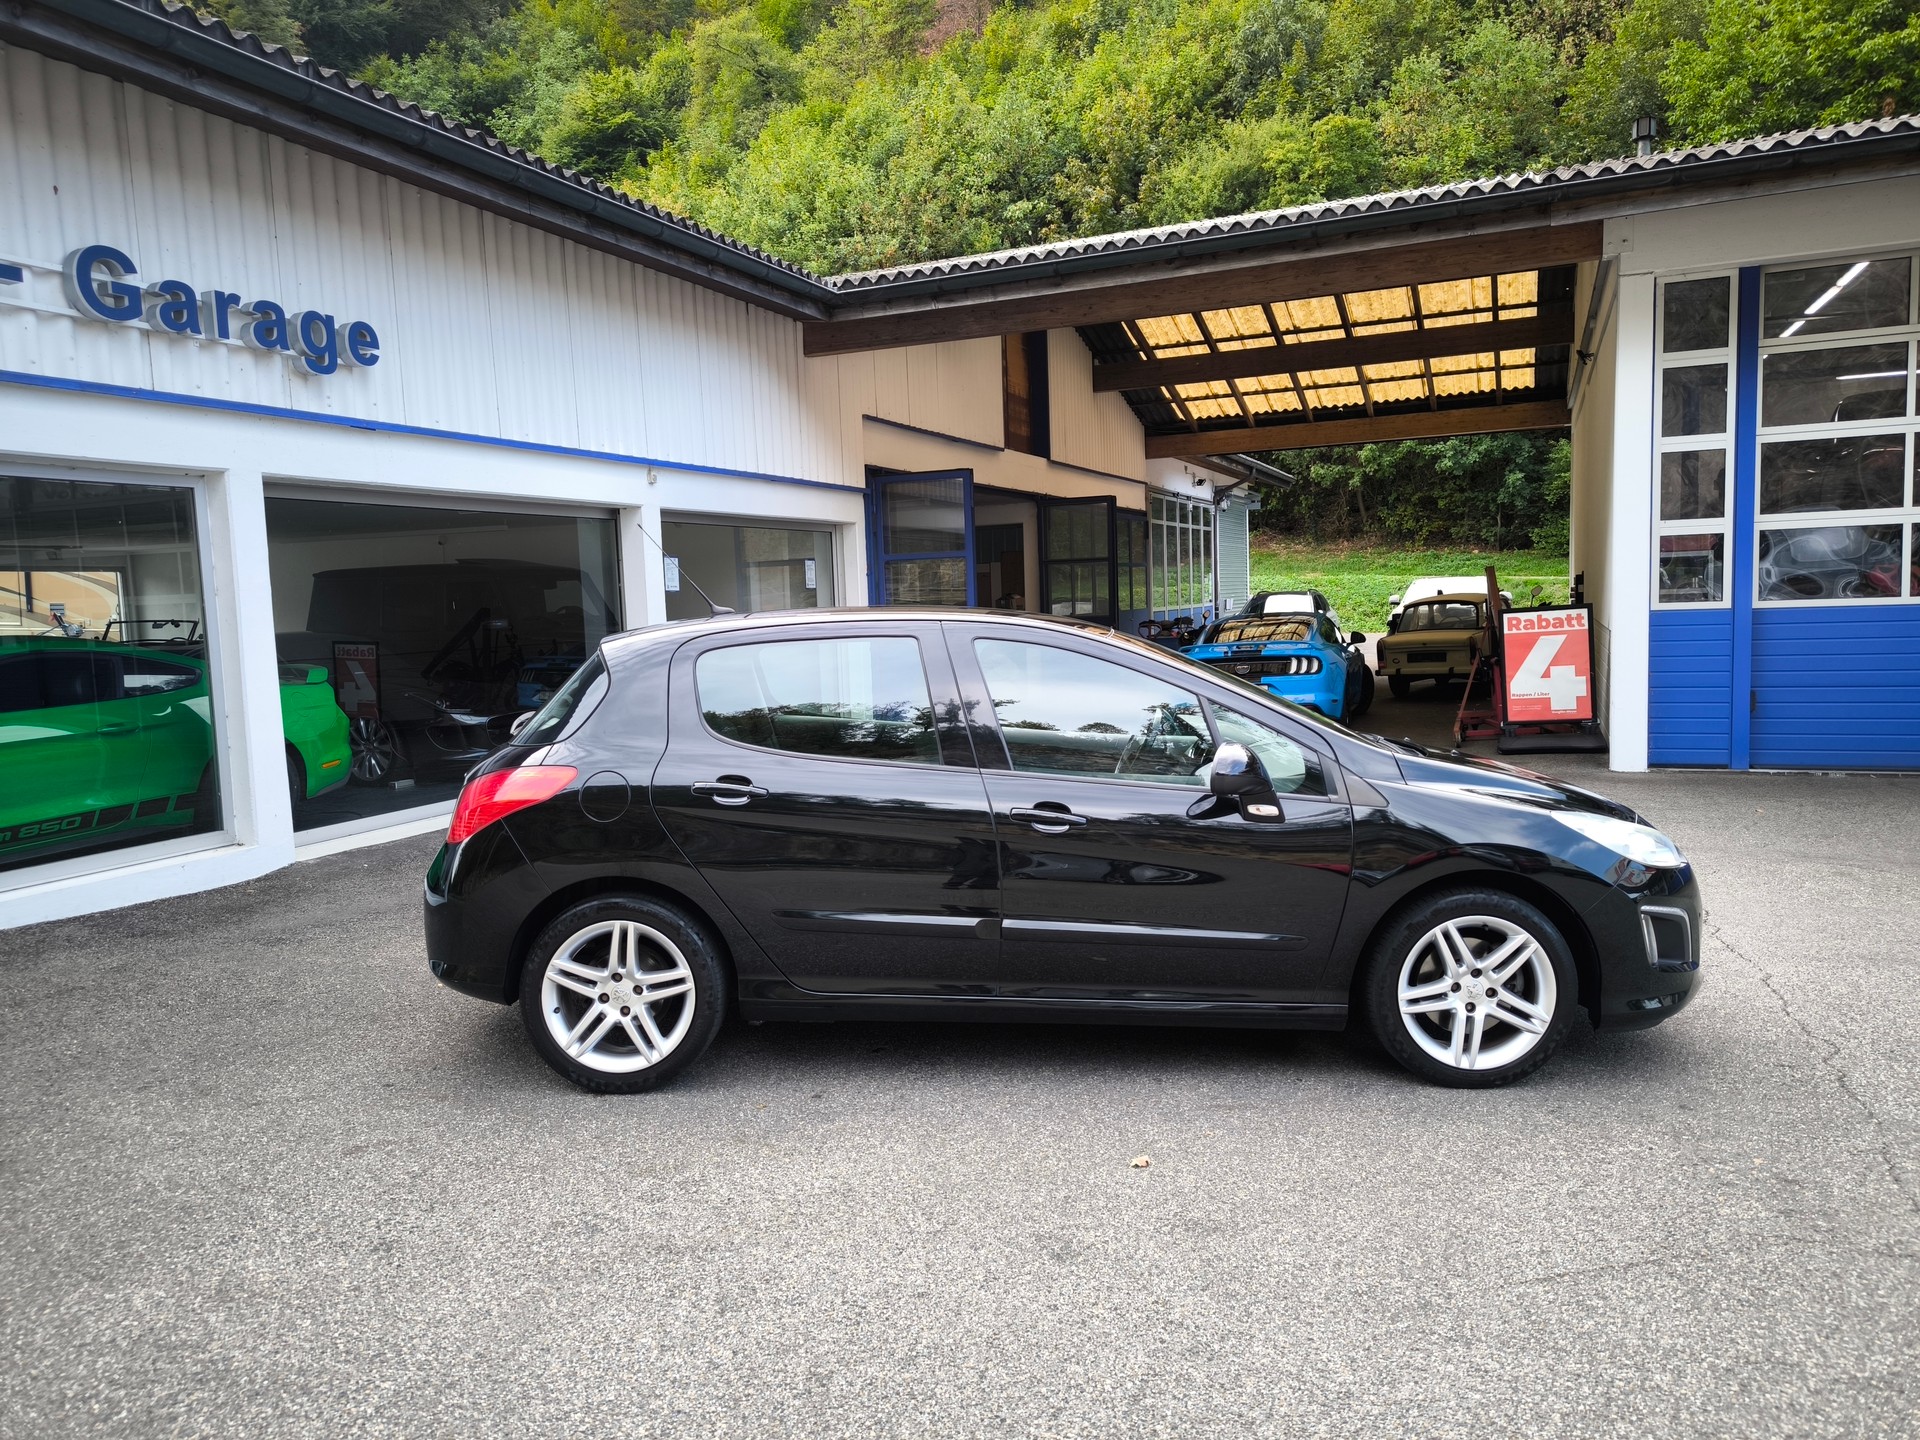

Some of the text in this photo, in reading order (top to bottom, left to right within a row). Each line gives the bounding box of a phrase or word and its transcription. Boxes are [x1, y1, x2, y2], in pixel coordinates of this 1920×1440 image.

[66, 244, 380, 375] Garage
[1506, 613, 1585, 631] Rabatt
[1510, 634, 1587, 711] 4
[18, 816, 82, 838] 850
